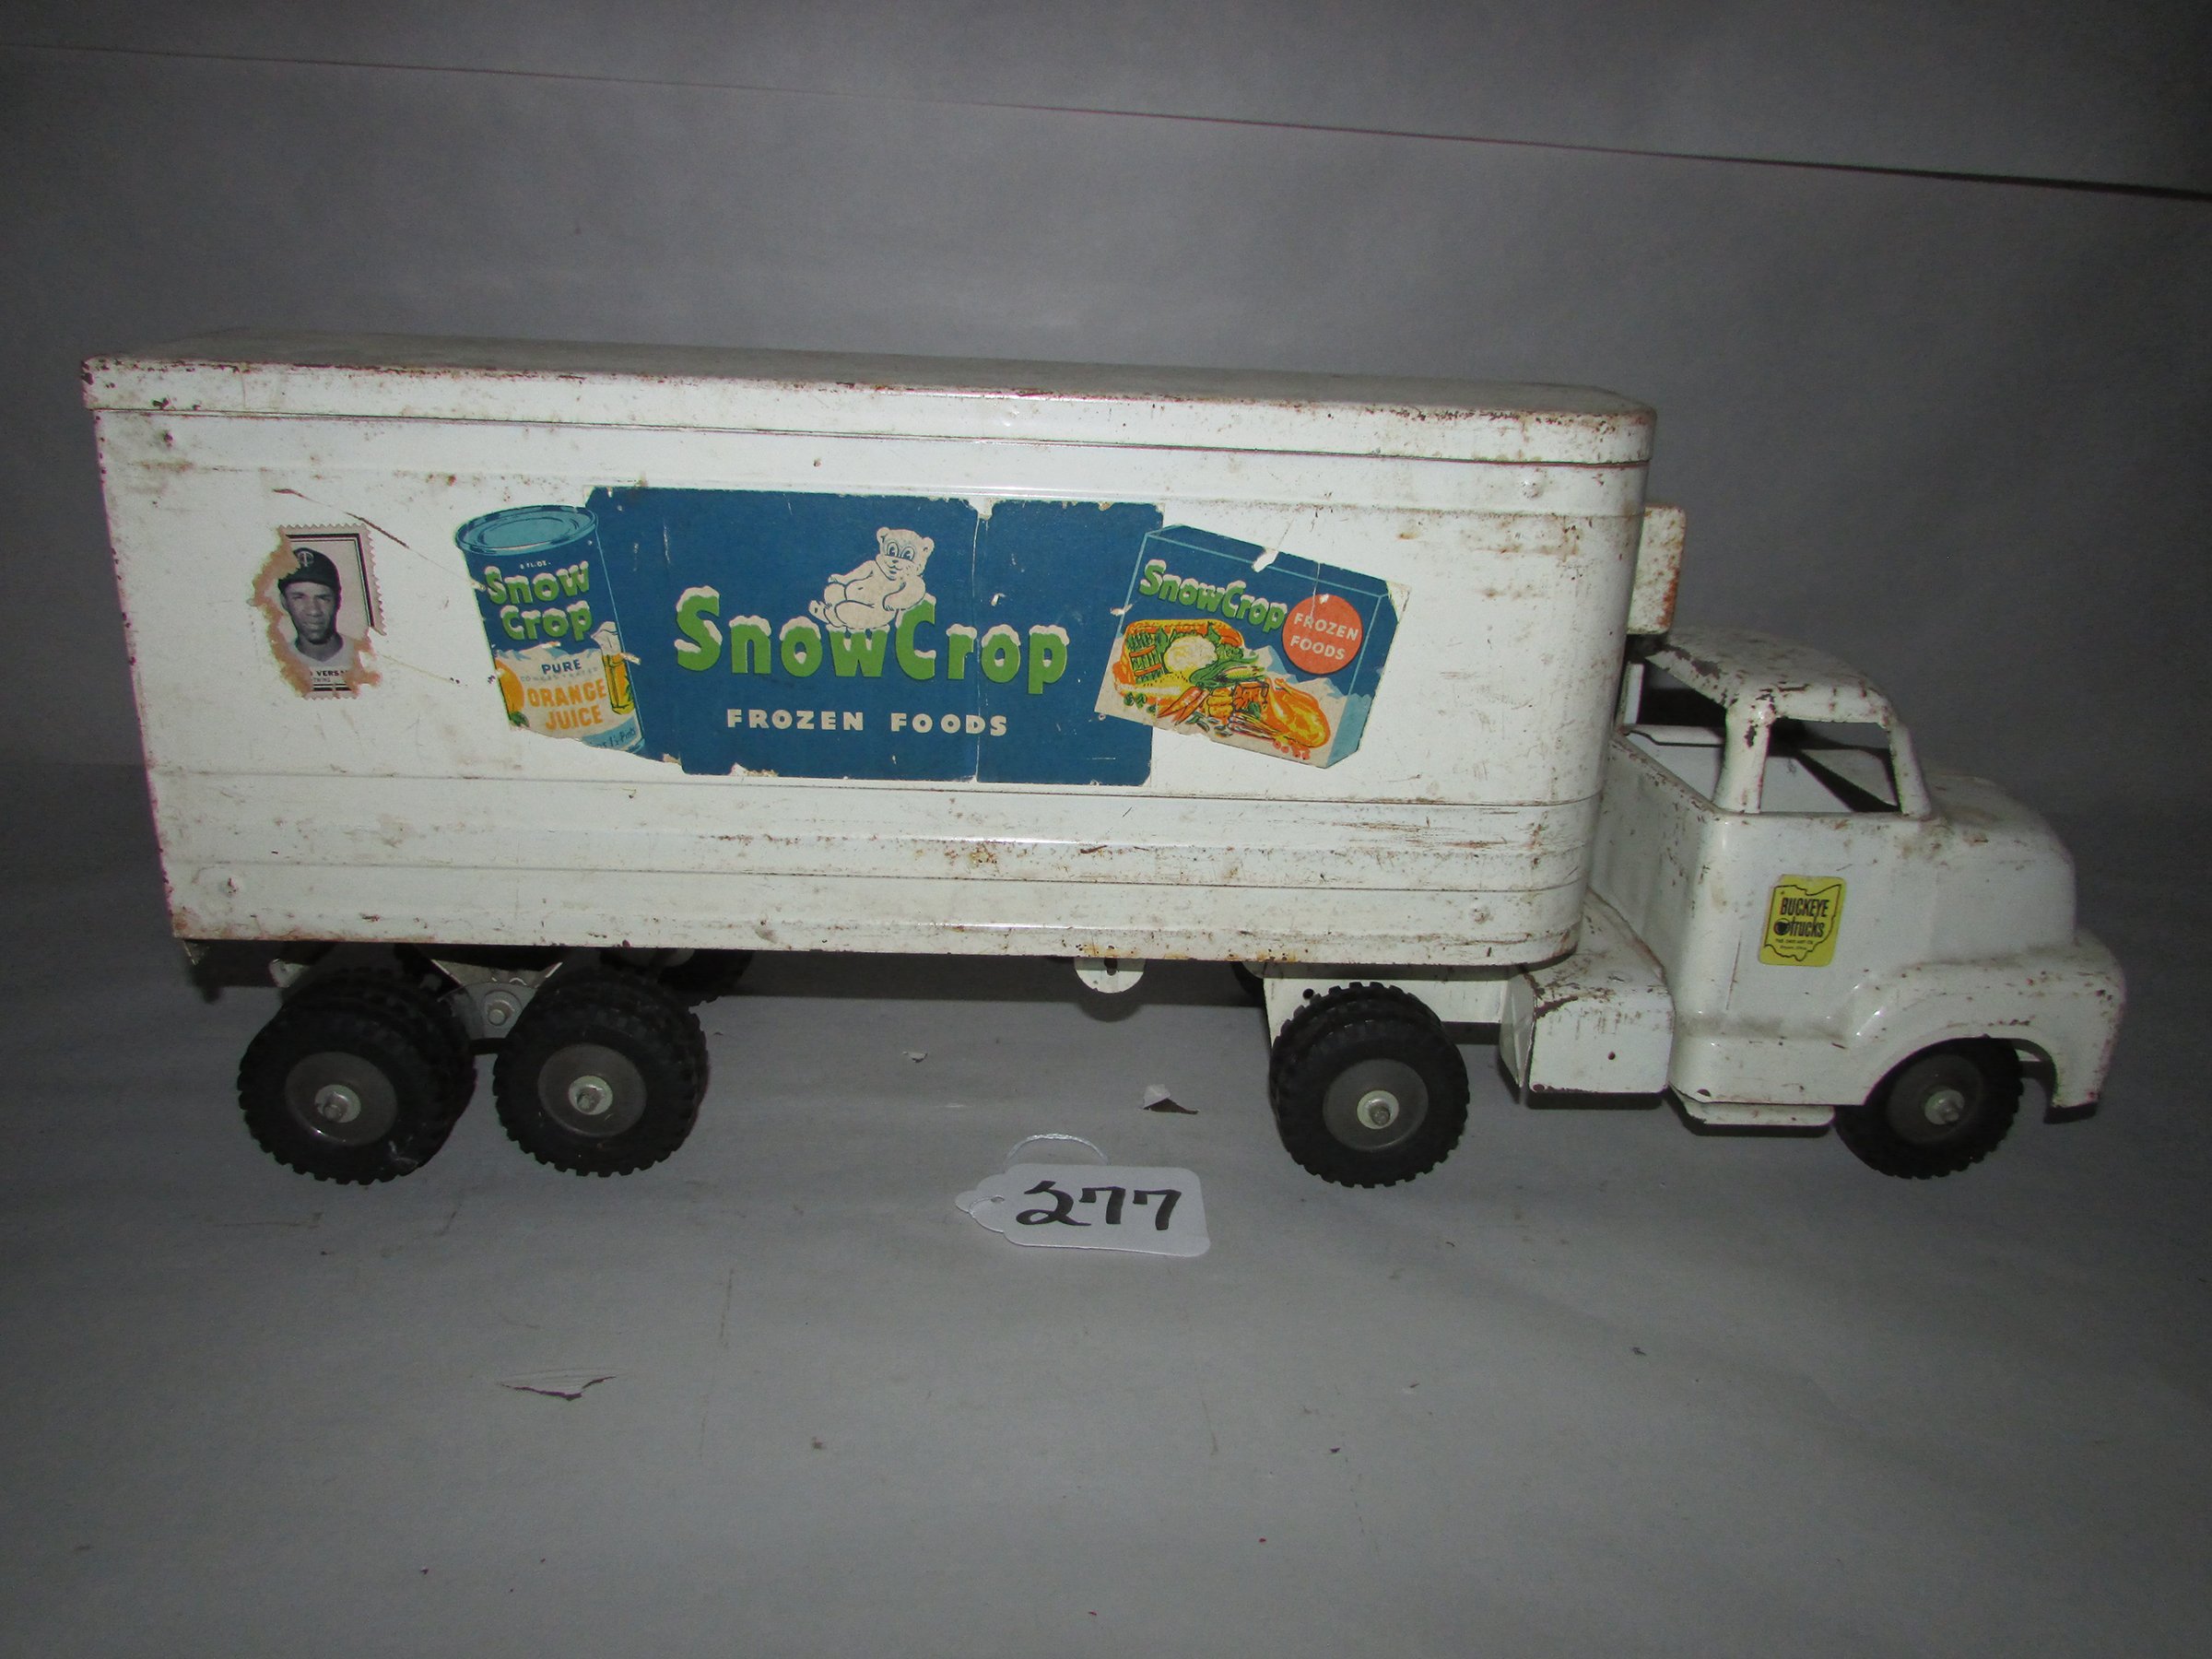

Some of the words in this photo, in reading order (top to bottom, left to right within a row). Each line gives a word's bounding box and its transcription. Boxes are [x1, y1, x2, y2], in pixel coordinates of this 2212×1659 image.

[484, 560, 590, 605] Snow
[500, 600, 594, 641] Crop
[1293, 612, 1359, 642] FROZEN
[1290, 635, 1347, 661] FOODS
[541, 659, 582, 675] PURE
[526, 678, 608, 708] ORANGE
[545, 704, 604, 731] JUICE
[726, 708, 865, 733] FROZEN
[890, 712, 1008, 736] FOODS
[1780, 897, 1830, 917] BUCKEYE
[1016, 1180, 1182, 1230] 277
